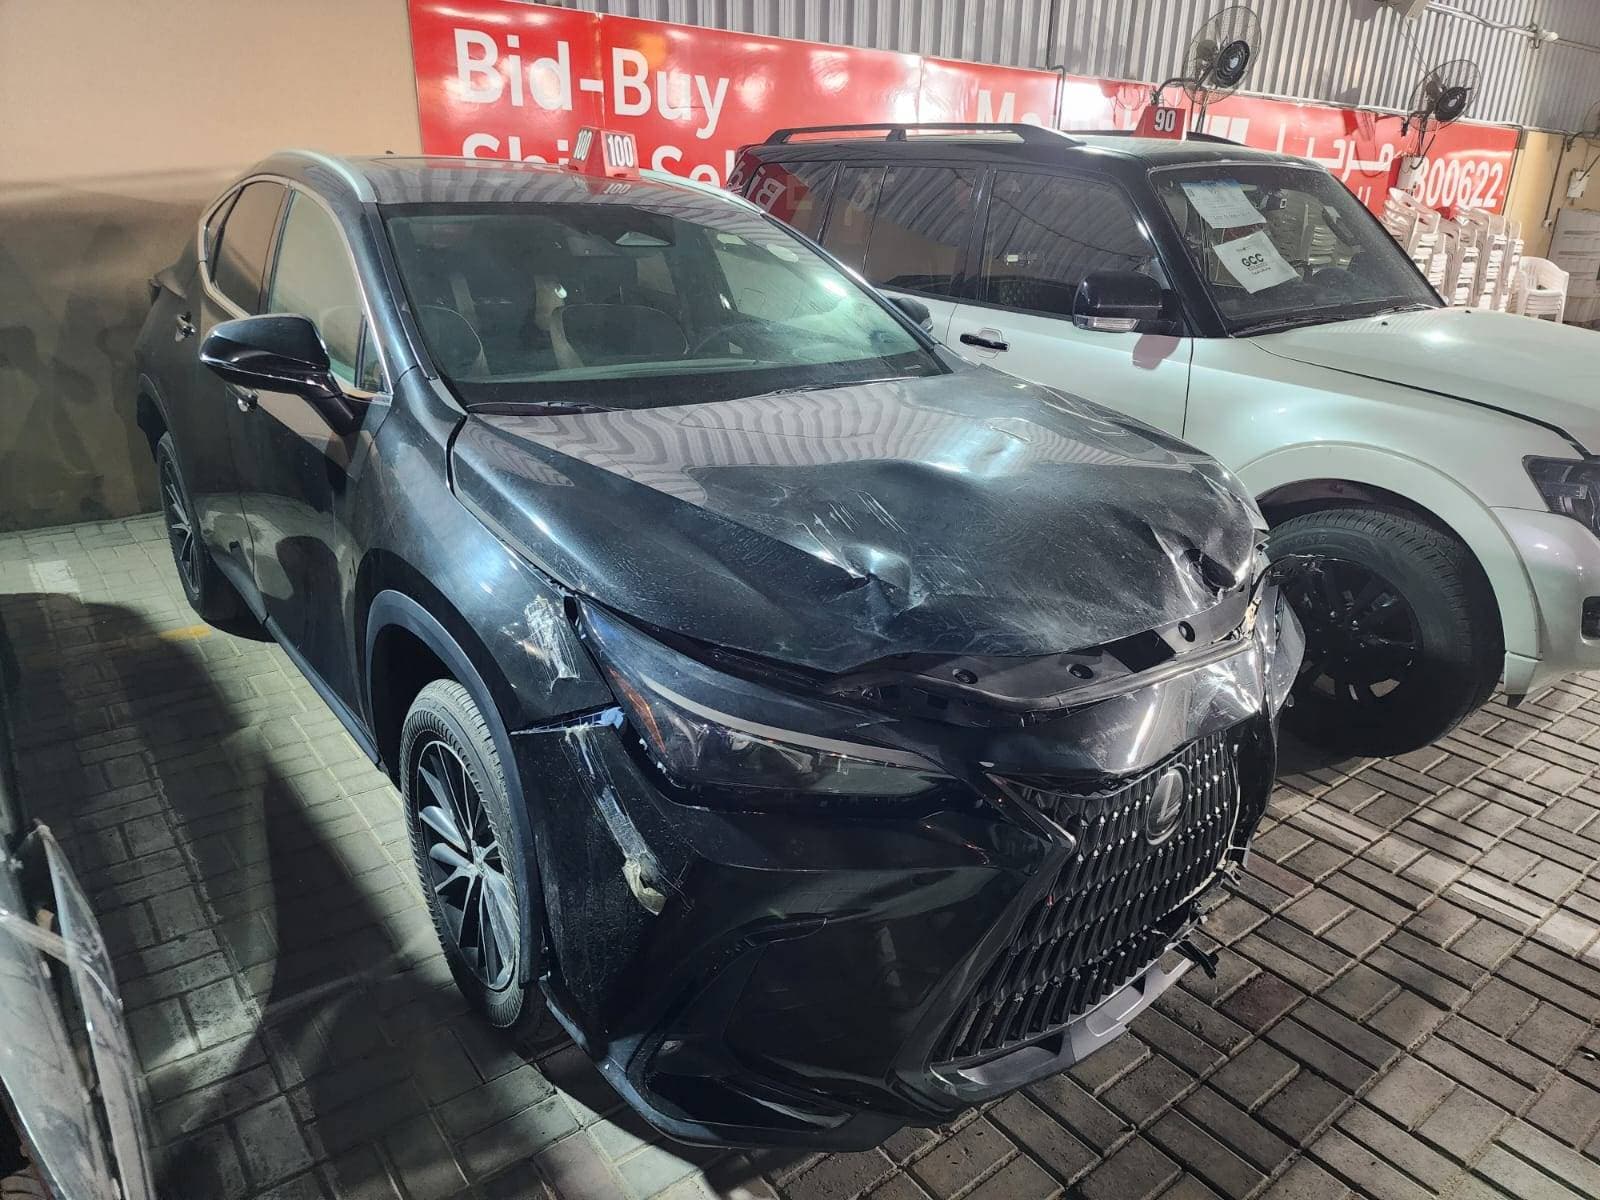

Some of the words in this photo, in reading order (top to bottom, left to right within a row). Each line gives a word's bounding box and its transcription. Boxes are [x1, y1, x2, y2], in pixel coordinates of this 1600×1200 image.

[454, 27, 730, 140] Bid-Buy
[1154, 108, 1176, 132] 90
[607, 134, 634, 167] 100
[1242, 253, 1266, 267] GCC
